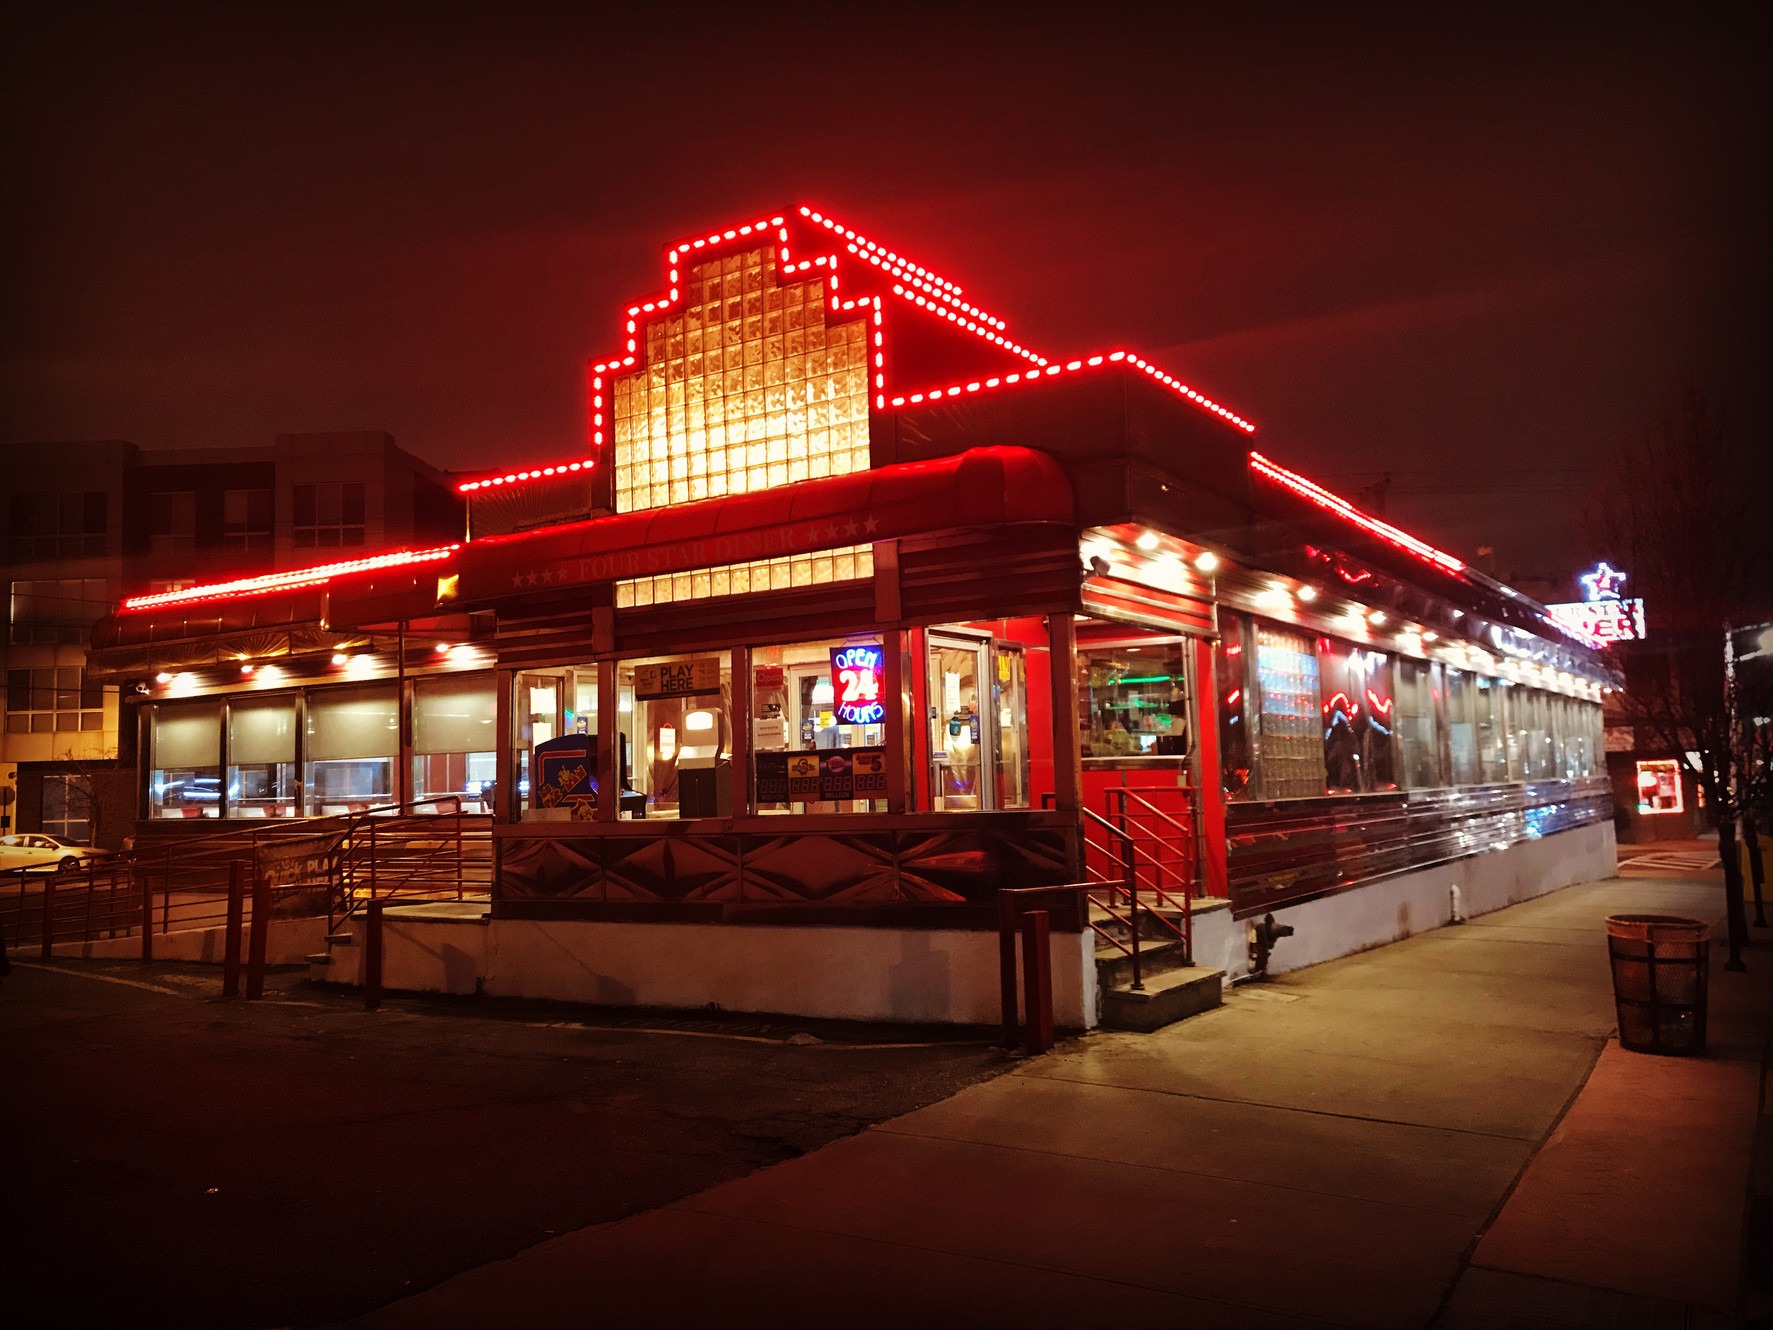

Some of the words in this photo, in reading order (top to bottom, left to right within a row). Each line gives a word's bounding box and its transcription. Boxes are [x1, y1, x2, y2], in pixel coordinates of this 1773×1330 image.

[580, 551, 640, 579] FOUR
[647, 541, 706, 569] STAR
[714, 527, 794, 560] DINER
[835, 648, 878, 669] OPEN
[661, 664, 694, 679] PLAY
[661, 677, 693, 691] HERE
[839, 668, 879, 701] 24
[838, 701, 884, 723] HOURS
